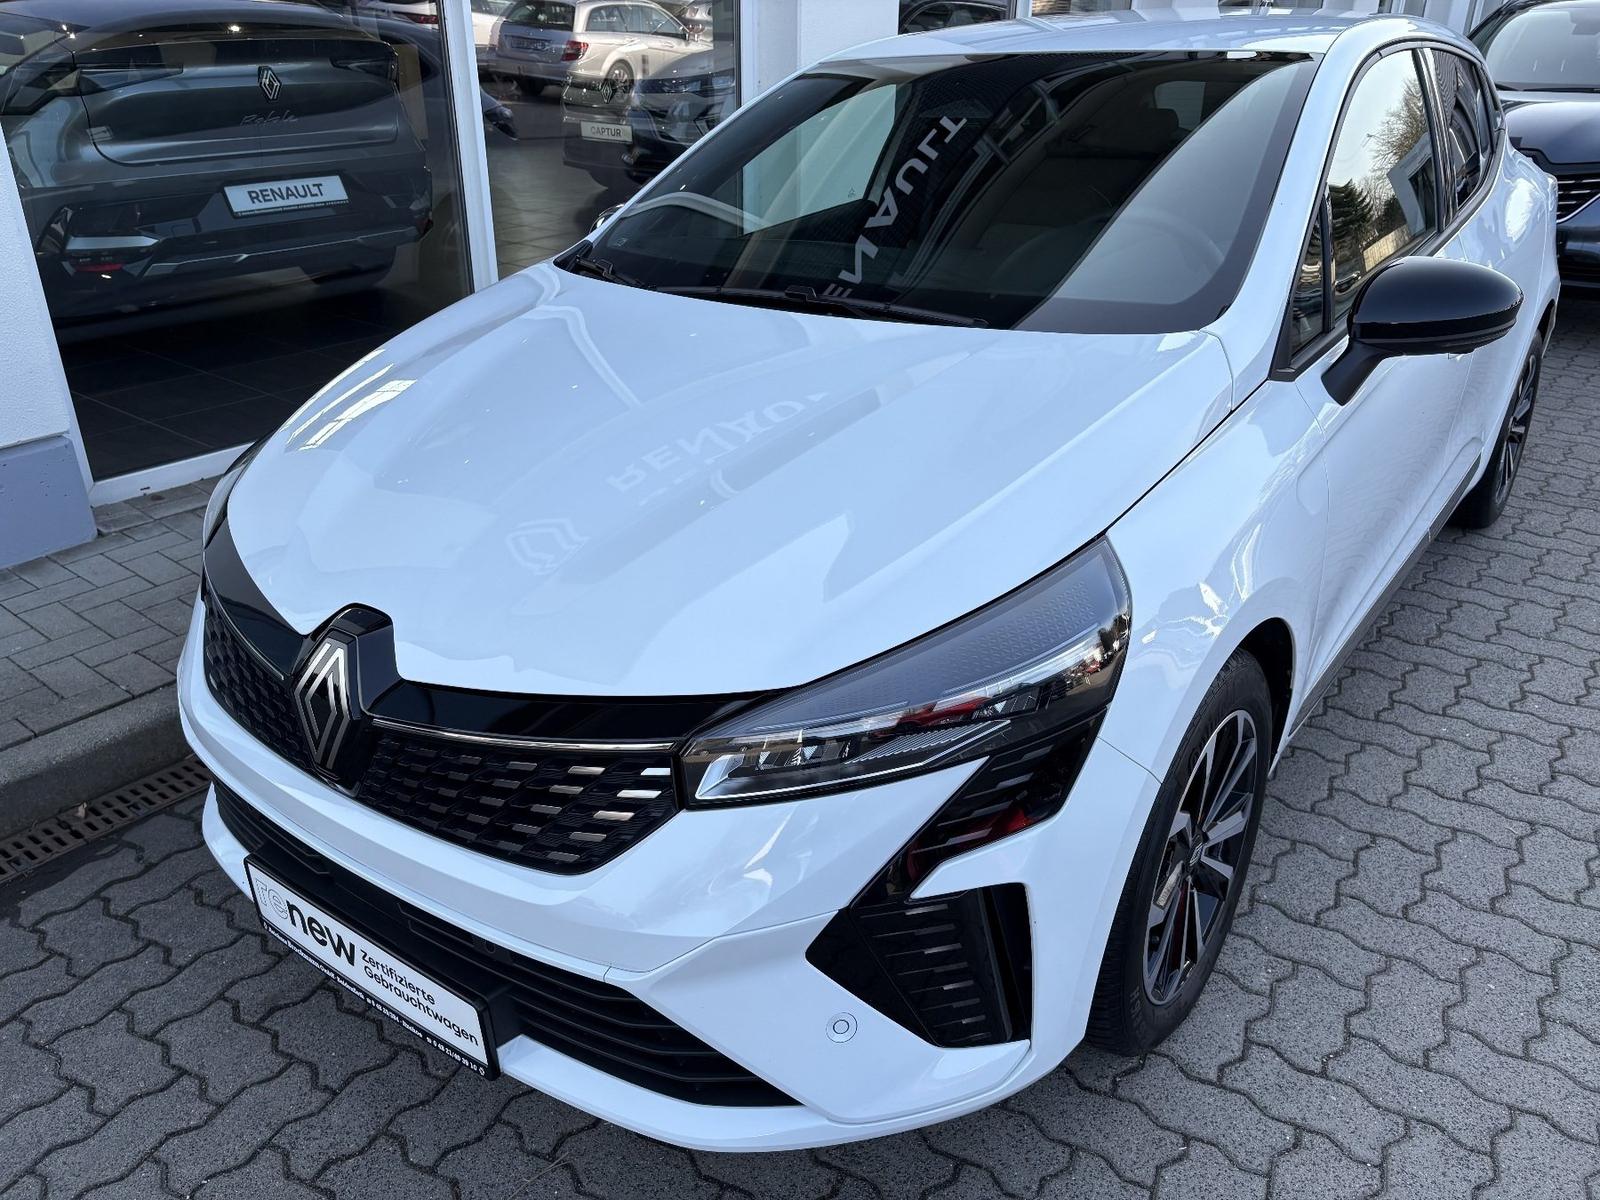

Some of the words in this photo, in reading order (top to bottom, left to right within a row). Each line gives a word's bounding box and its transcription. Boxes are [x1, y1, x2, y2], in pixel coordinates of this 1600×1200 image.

[590, 125, 622, 137] CAPTUR
[247, 183, 324, 204] RENAULT
[255, 877, 356, 967] renew
[360, 948, 436, 1006] Zertifizierte
[364, 965, 479, 1046] Gebrauchtwagen
